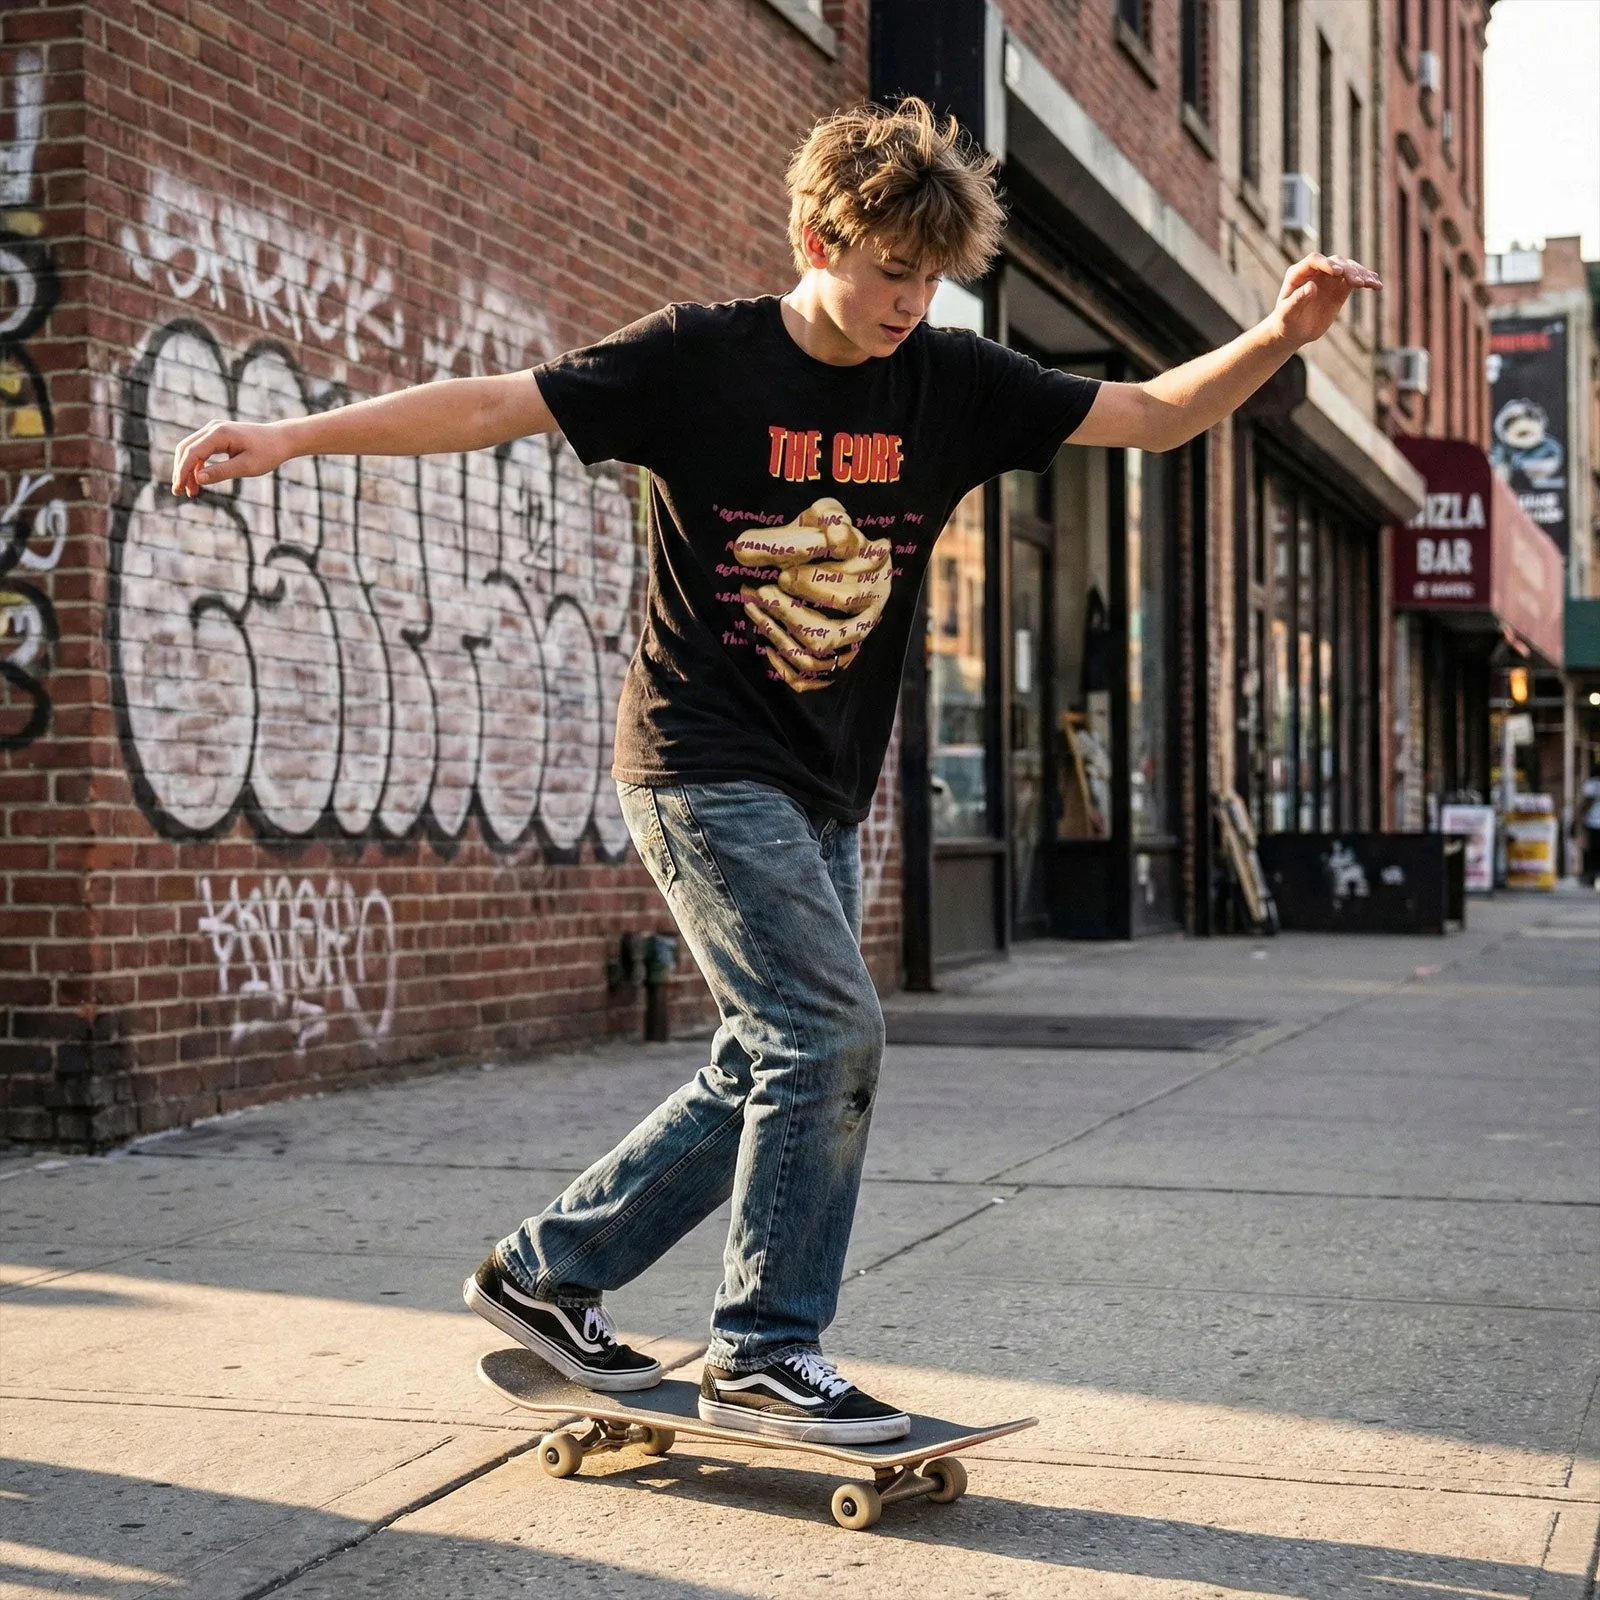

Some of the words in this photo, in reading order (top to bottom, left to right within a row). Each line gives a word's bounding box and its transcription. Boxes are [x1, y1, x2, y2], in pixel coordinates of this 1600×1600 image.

[768, 425, 822, 482] THE
[832, 432, 904, 484] CURE
[1416, 538, 1472, 575] BAR
